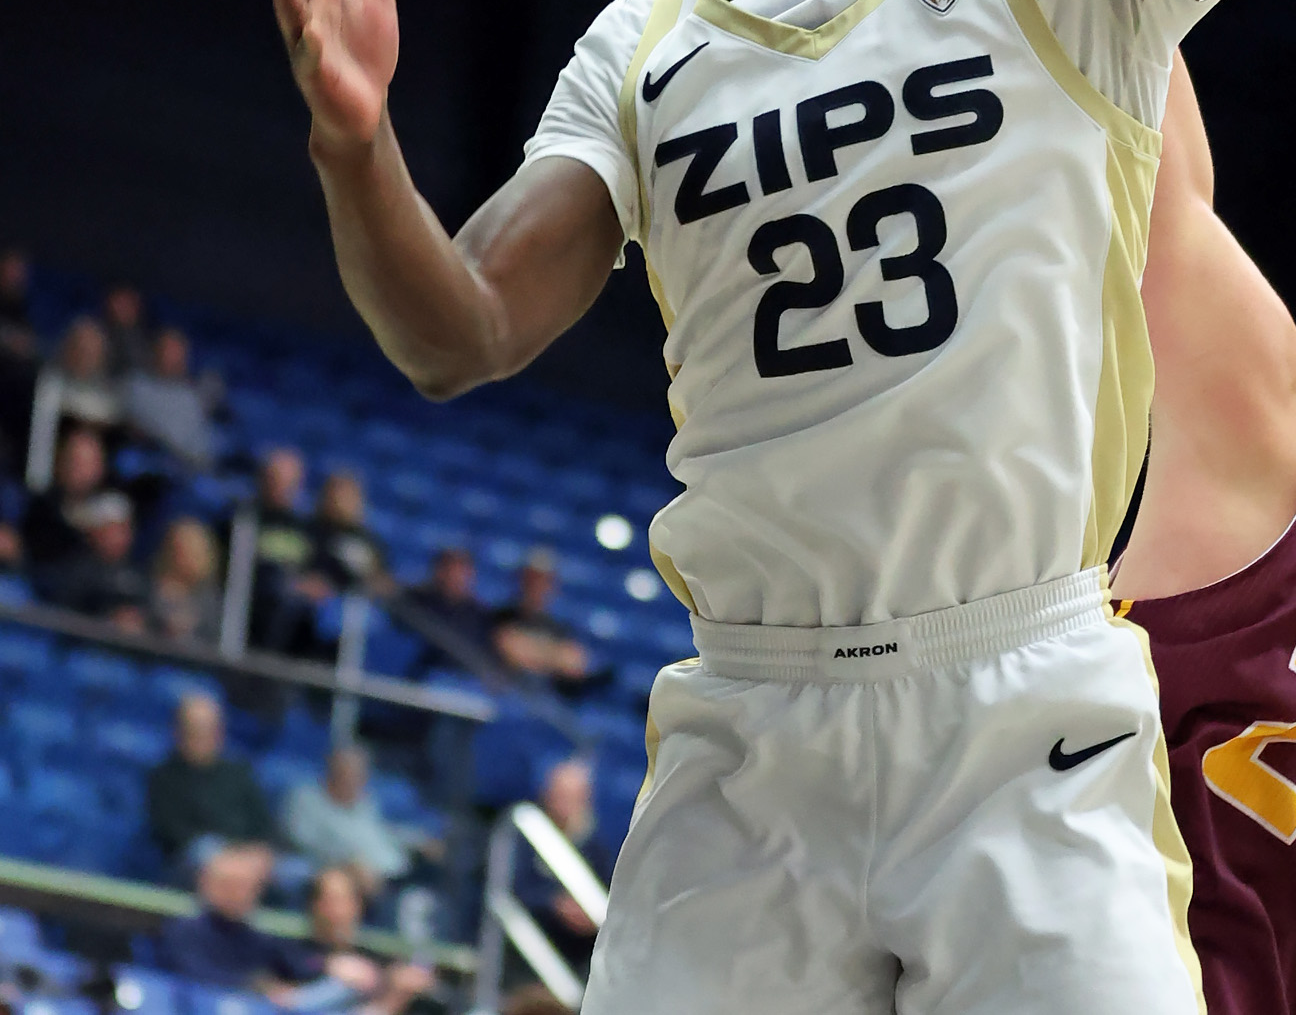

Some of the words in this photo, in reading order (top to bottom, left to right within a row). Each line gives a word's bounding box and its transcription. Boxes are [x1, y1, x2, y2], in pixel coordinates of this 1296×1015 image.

[655, 54, 1004, 225] ZIPS
[747, 183, 959, 379] 23
[834, 642, 898, 658] AKRON
